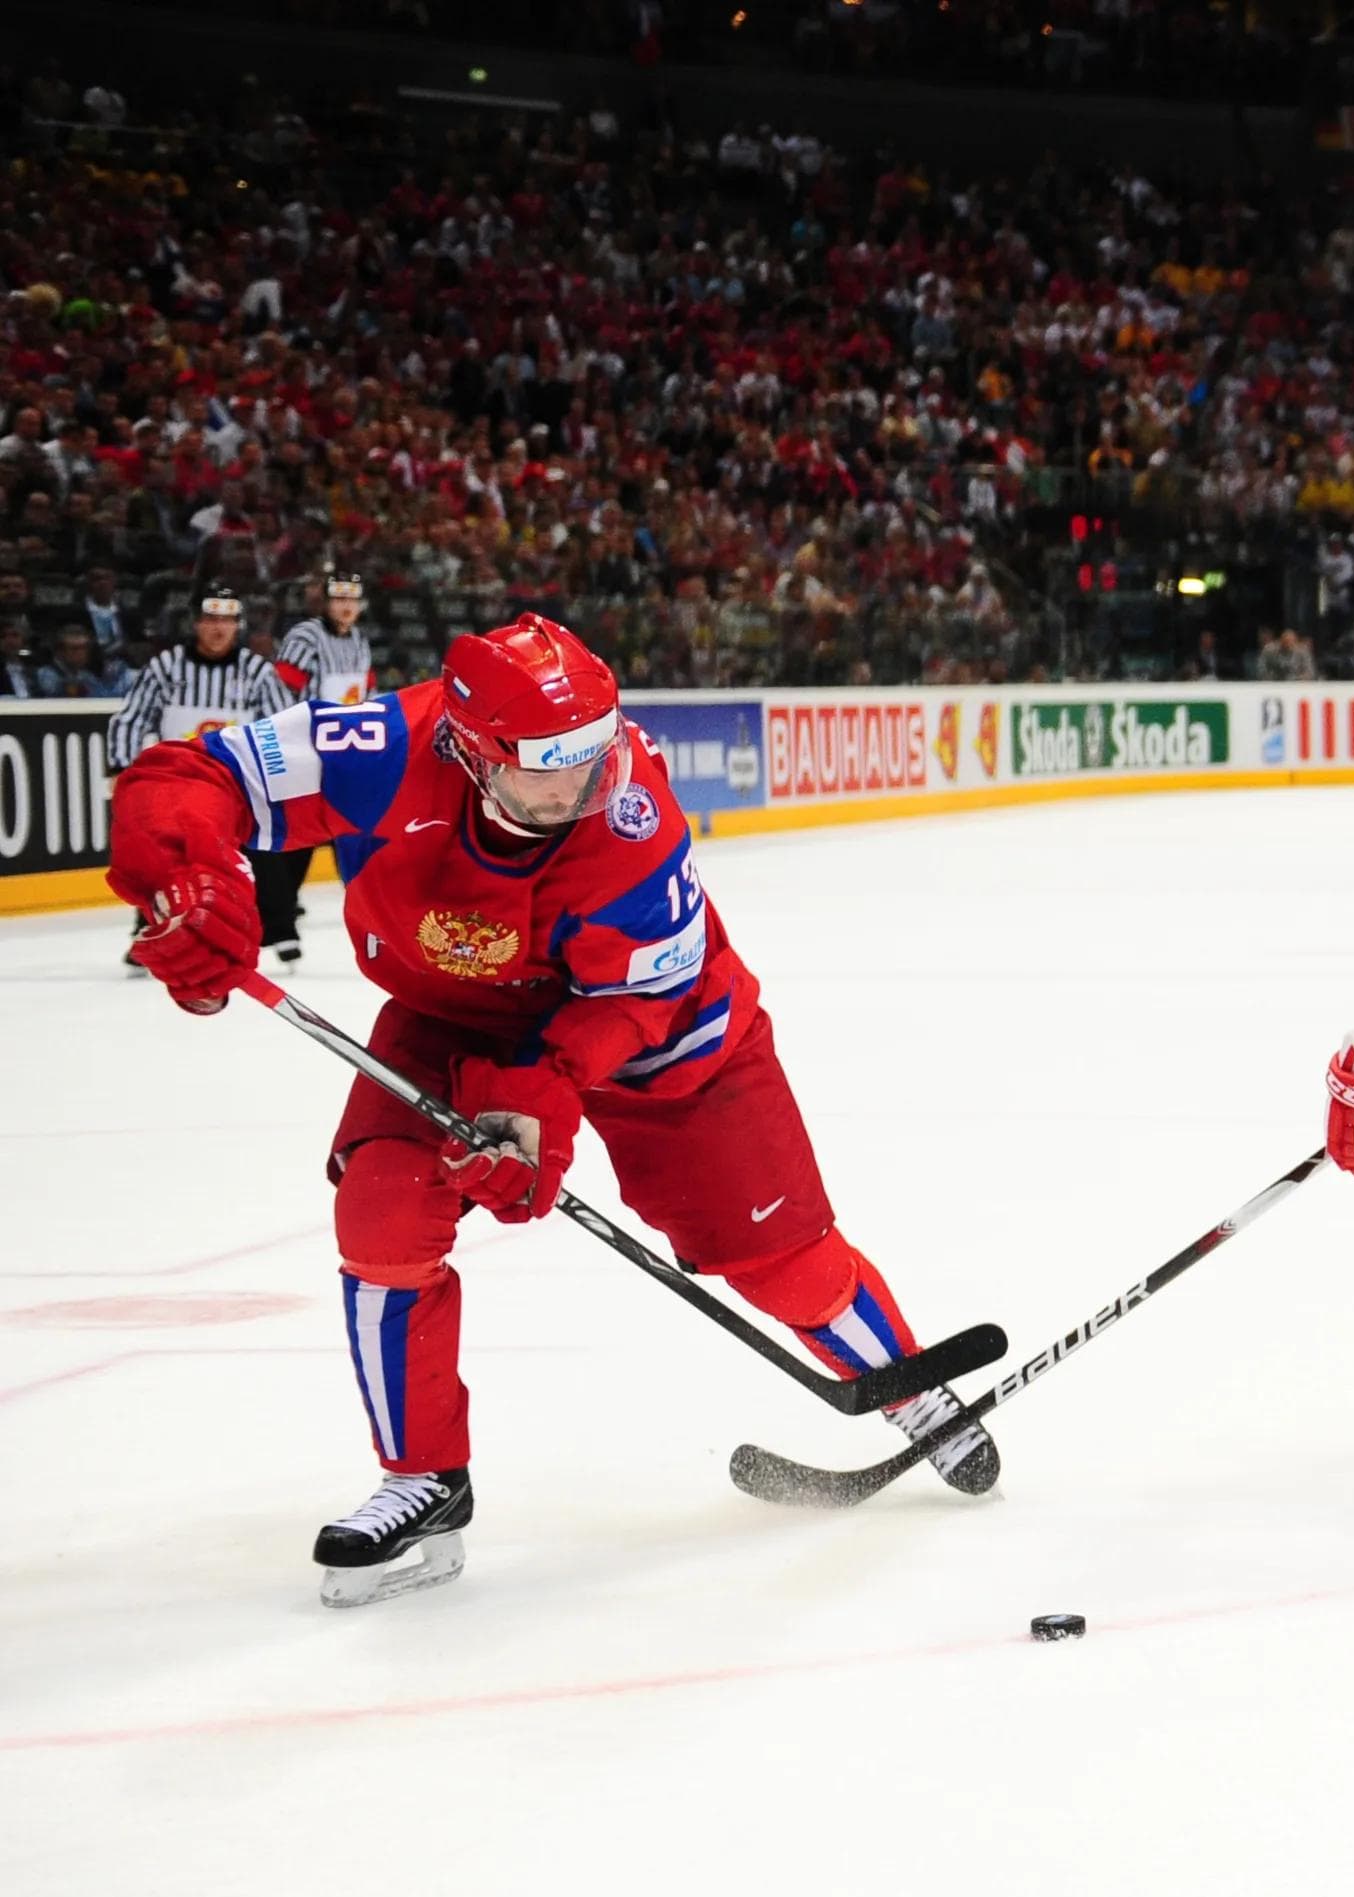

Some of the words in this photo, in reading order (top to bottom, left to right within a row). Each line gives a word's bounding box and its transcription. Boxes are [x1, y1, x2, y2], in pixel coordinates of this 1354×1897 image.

[315, 701, 386, 751] 13
[768, 704, 927, 798] BAUHAUS
[667, 847, 701, 924] 13
[994, 1276, 1152, 1407] BAUER
